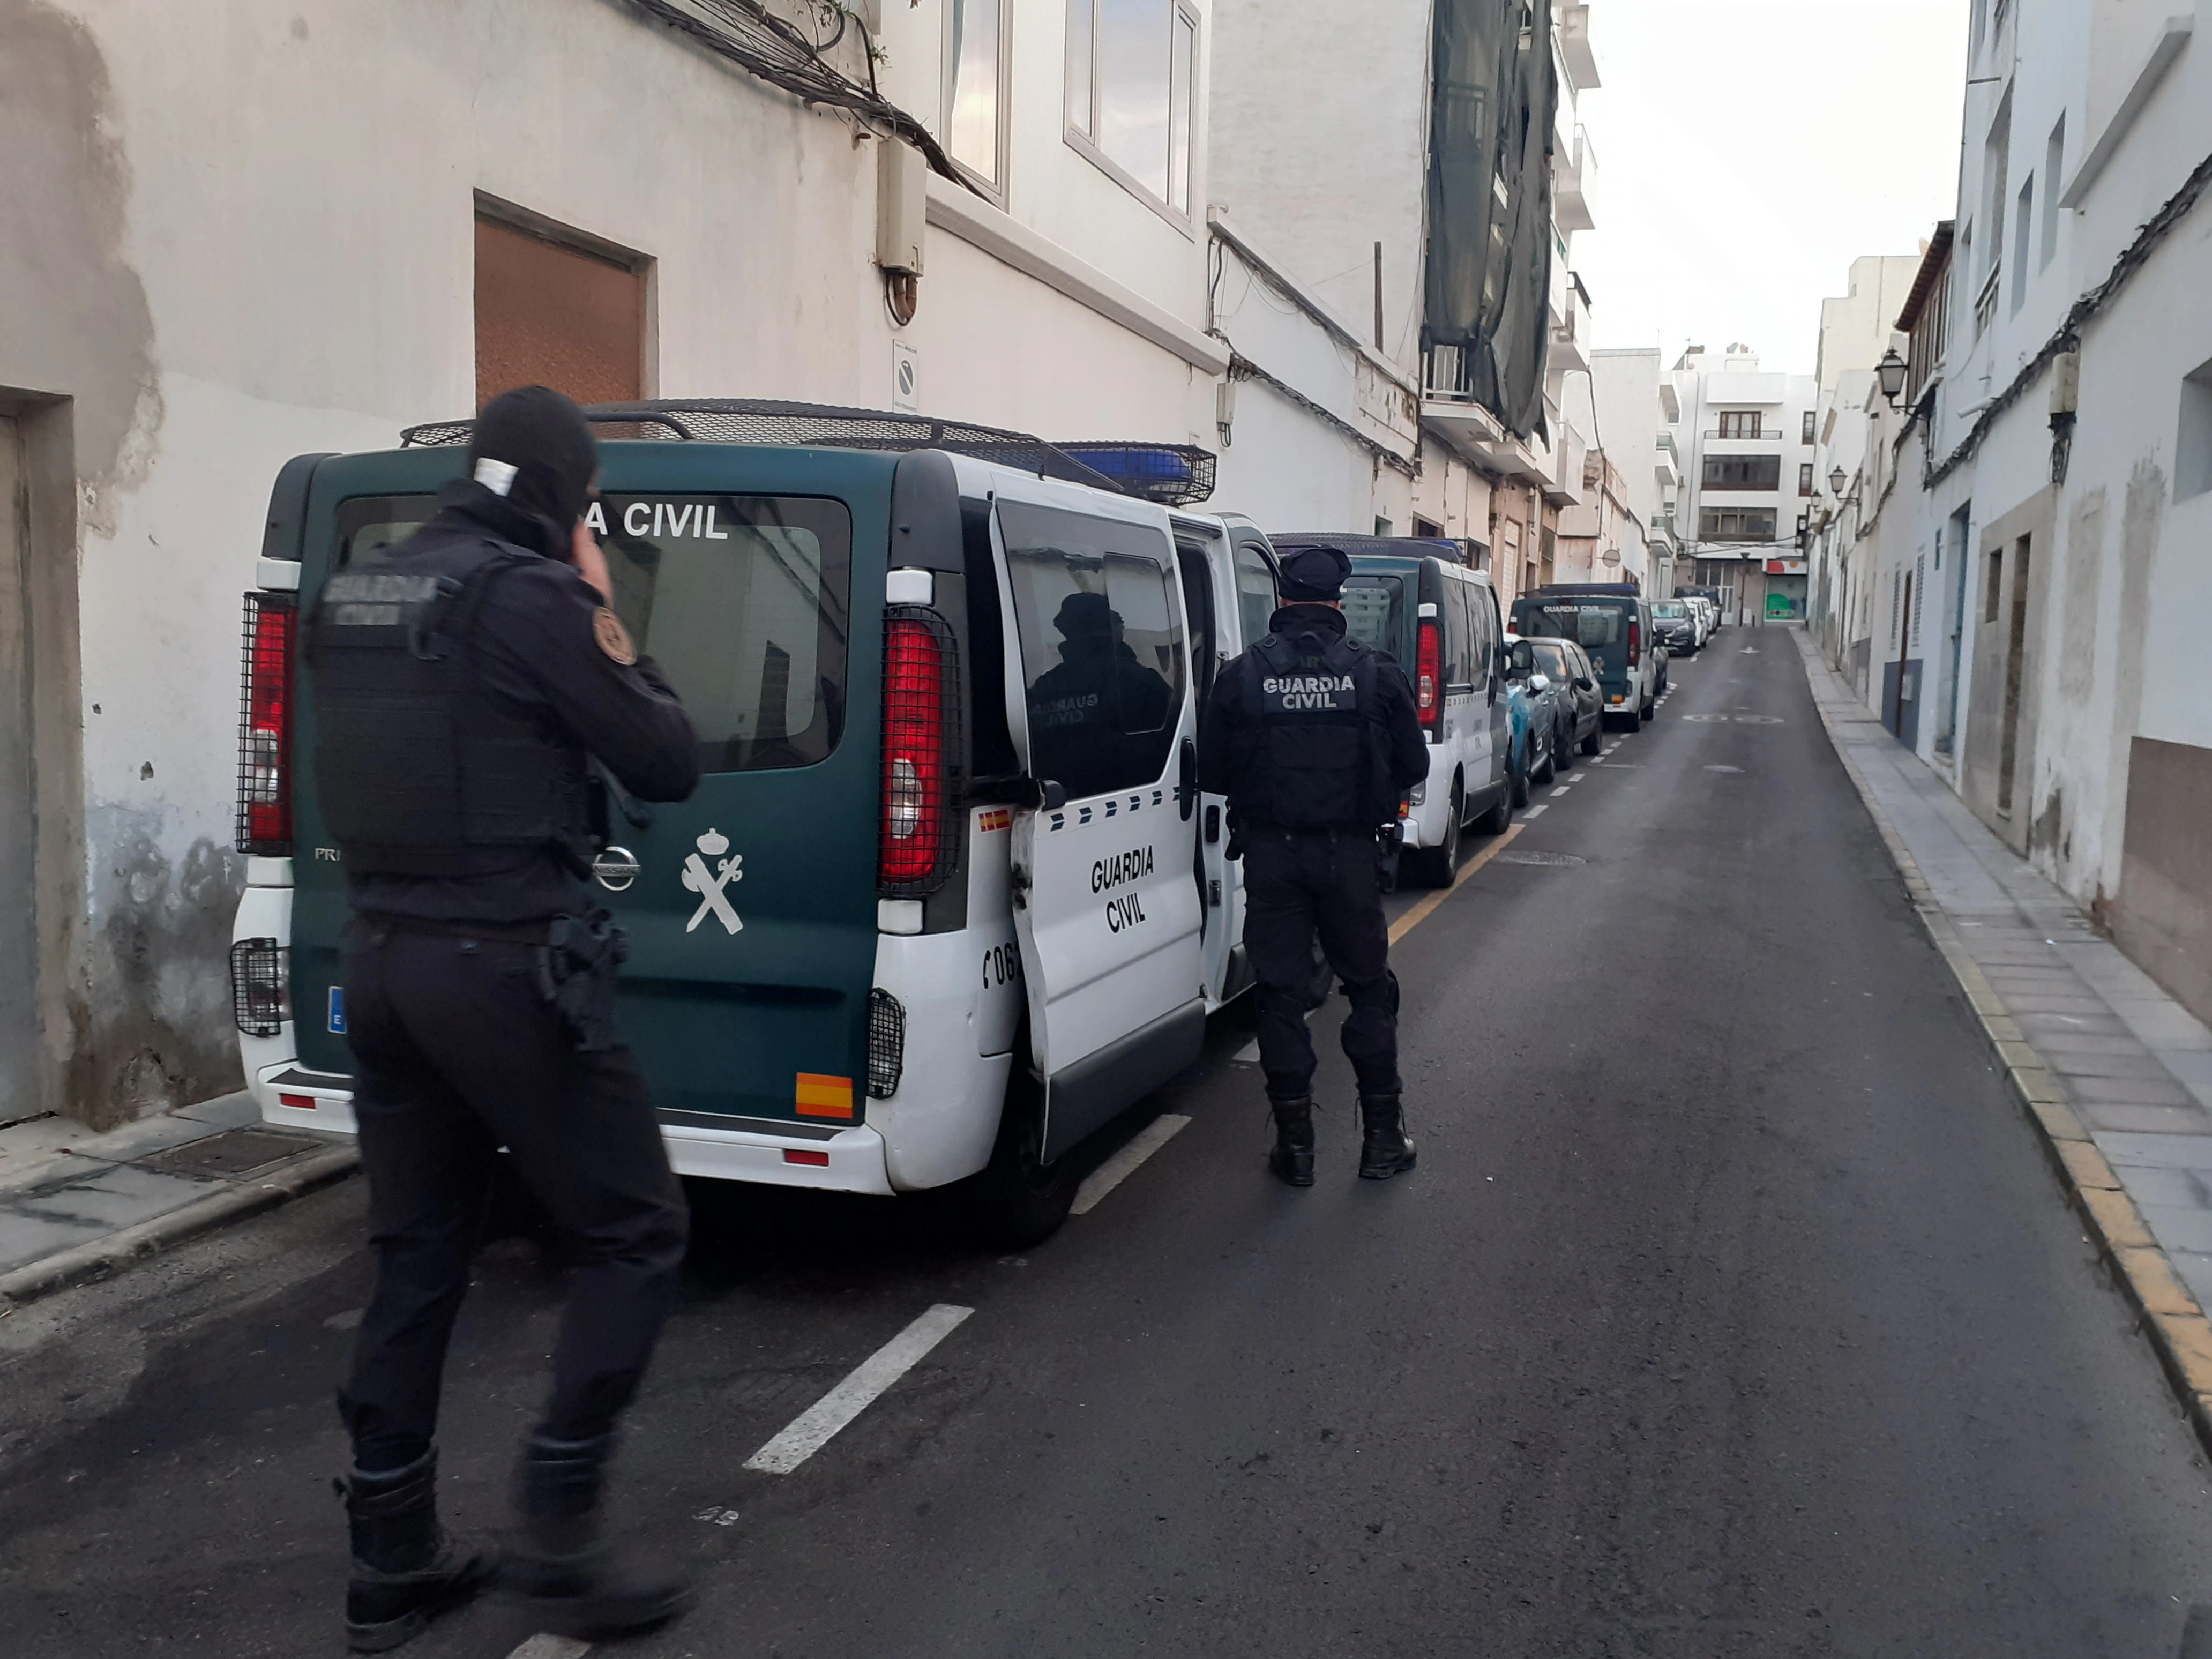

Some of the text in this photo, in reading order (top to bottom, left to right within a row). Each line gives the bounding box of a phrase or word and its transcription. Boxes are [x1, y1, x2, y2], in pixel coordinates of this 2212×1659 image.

[624, 502, 728, 540] CIVIL
[1543, 605, 1579, 613] GUARDIA
[1263, 675, 1355, 693] GUARDIA
[1282, 693, 1337, 709] CIVIL
[1091, 845, 1154, 894] GUARDIA
[1106, 892, 1146, 933] CIVIL
[994, 941, 1023, 985] 06
[333, 1014, 341, 1025] E
